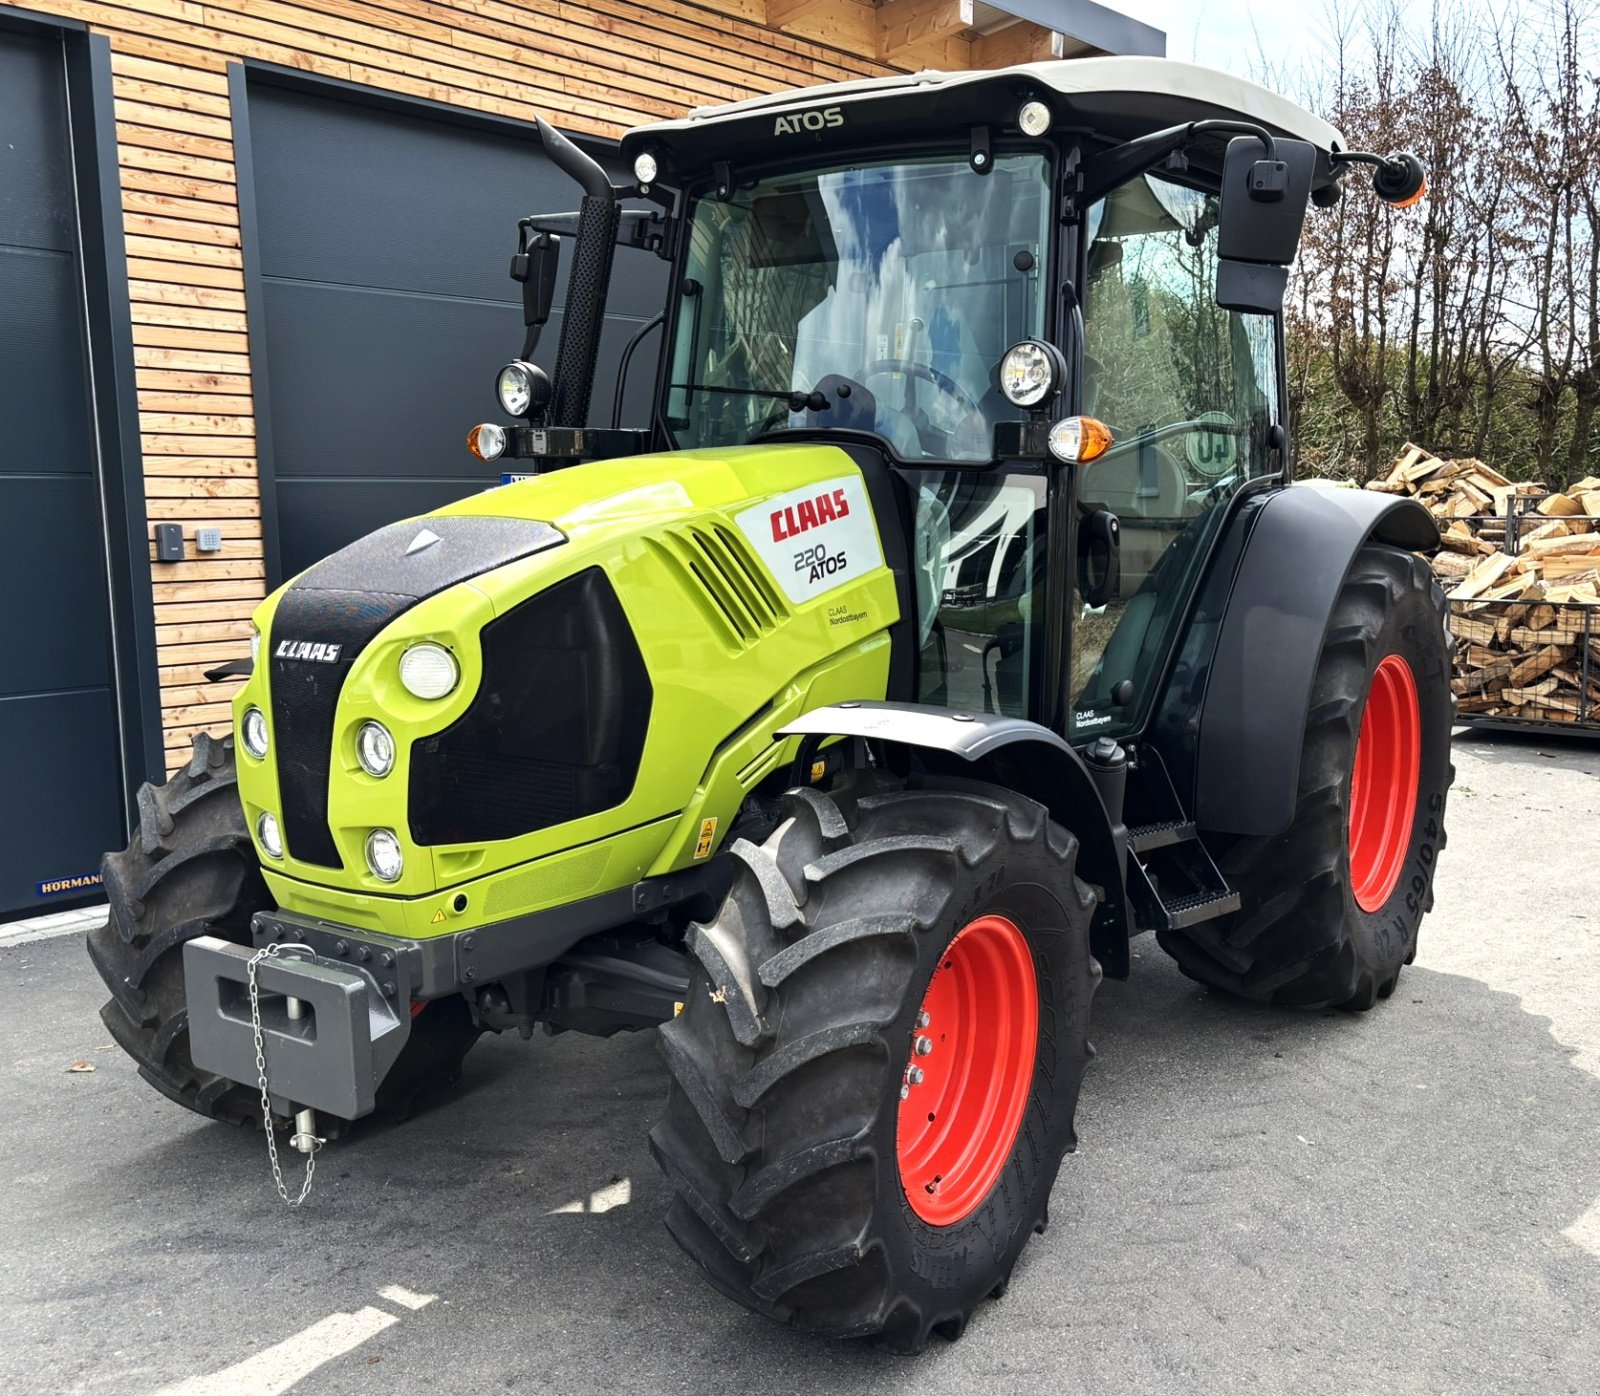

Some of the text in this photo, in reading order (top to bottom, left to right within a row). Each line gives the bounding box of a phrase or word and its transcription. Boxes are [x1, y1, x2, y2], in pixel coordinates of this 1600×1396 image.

[774, 107, 844, 136] ATOS
[770, 488, 850, 543] CLAAS
[793, 543, 827, 572] 220
[808, 550, 847, 584] ATOS
[828, 605, 848, 617] CLAAS
[275, 639, 342, 662] CLAAS
[1076, 709, 1095, 721] CLAAS
[1405, 792, 1443, 921] 540/65
[1392, 915, 1410, 946] R
